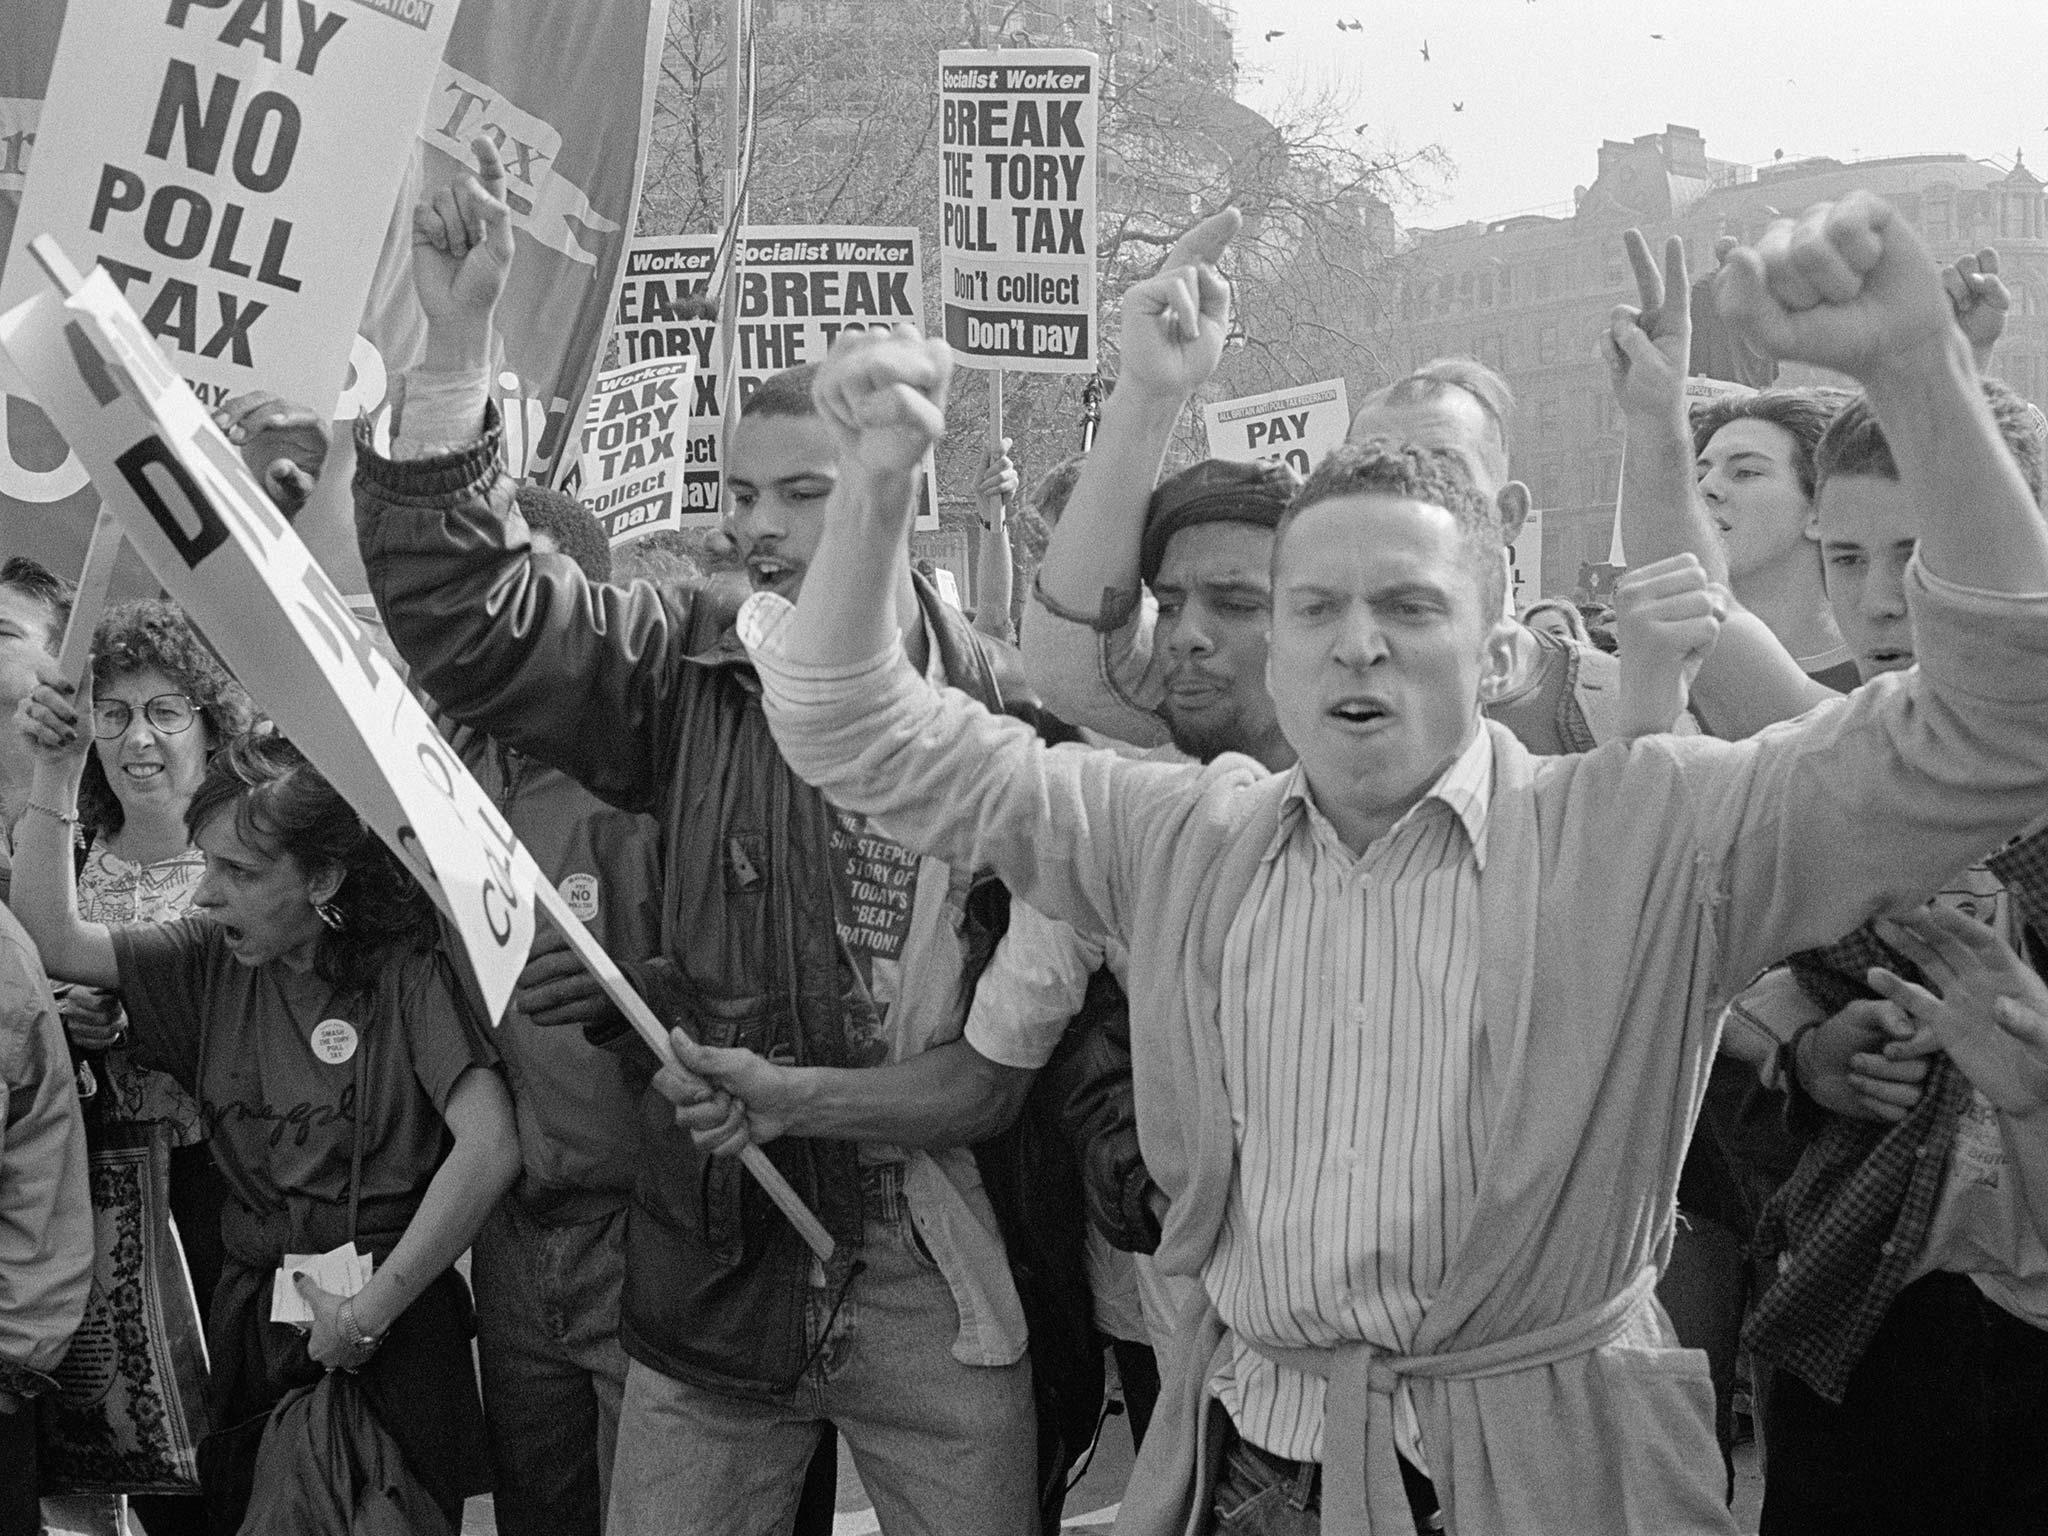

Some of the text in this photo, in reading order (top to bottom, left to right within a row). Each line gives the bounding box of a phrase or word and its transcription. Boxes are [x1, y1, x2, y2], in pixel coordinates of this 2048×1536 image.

[944, 69, 1086, 89] Socialist Worker
[145, 57, 302, 194] NO
[943, 99, 1085, 148] BREAK
[943, 151, 1086, 201] THE TORY
[89, 163, 302, 293] POLL
[944, 202, 1086, 254] POLL TAX
[633, 252, 711, 272] Worker
[735, 243, 909, 261] Socialist Worker
[736, 271, 914, 317] BREAK
[954, 267, 1080, 305] Don't collect
[625, 327, 716, 369] TORY
[738, 323, 806, 369] THE
[968, 316, 1080, 356] Don't pay
[184, 378, 231, 407] AY
[601, 364, 682, 392] Worker
[1218, 411, 1231, 421] ALL
[1269, 400, 1286, 411] POLL
[1299, 390, 1337, 406] FEDERATION
[1247, 411, 1310, 449] PAY
[600, 432, 675, 482] TAX
[1256, 448, 1311, 475] O
[580, 471, 666, 513] collect
[612, 500, 664, 535] pay
[845, 858, 916, 887] STORY OF
[571, 890, 591, 901] NO
[851, 880, 908, 910] TODAY'S
[852, 905, 905, 929] "BEAT"
